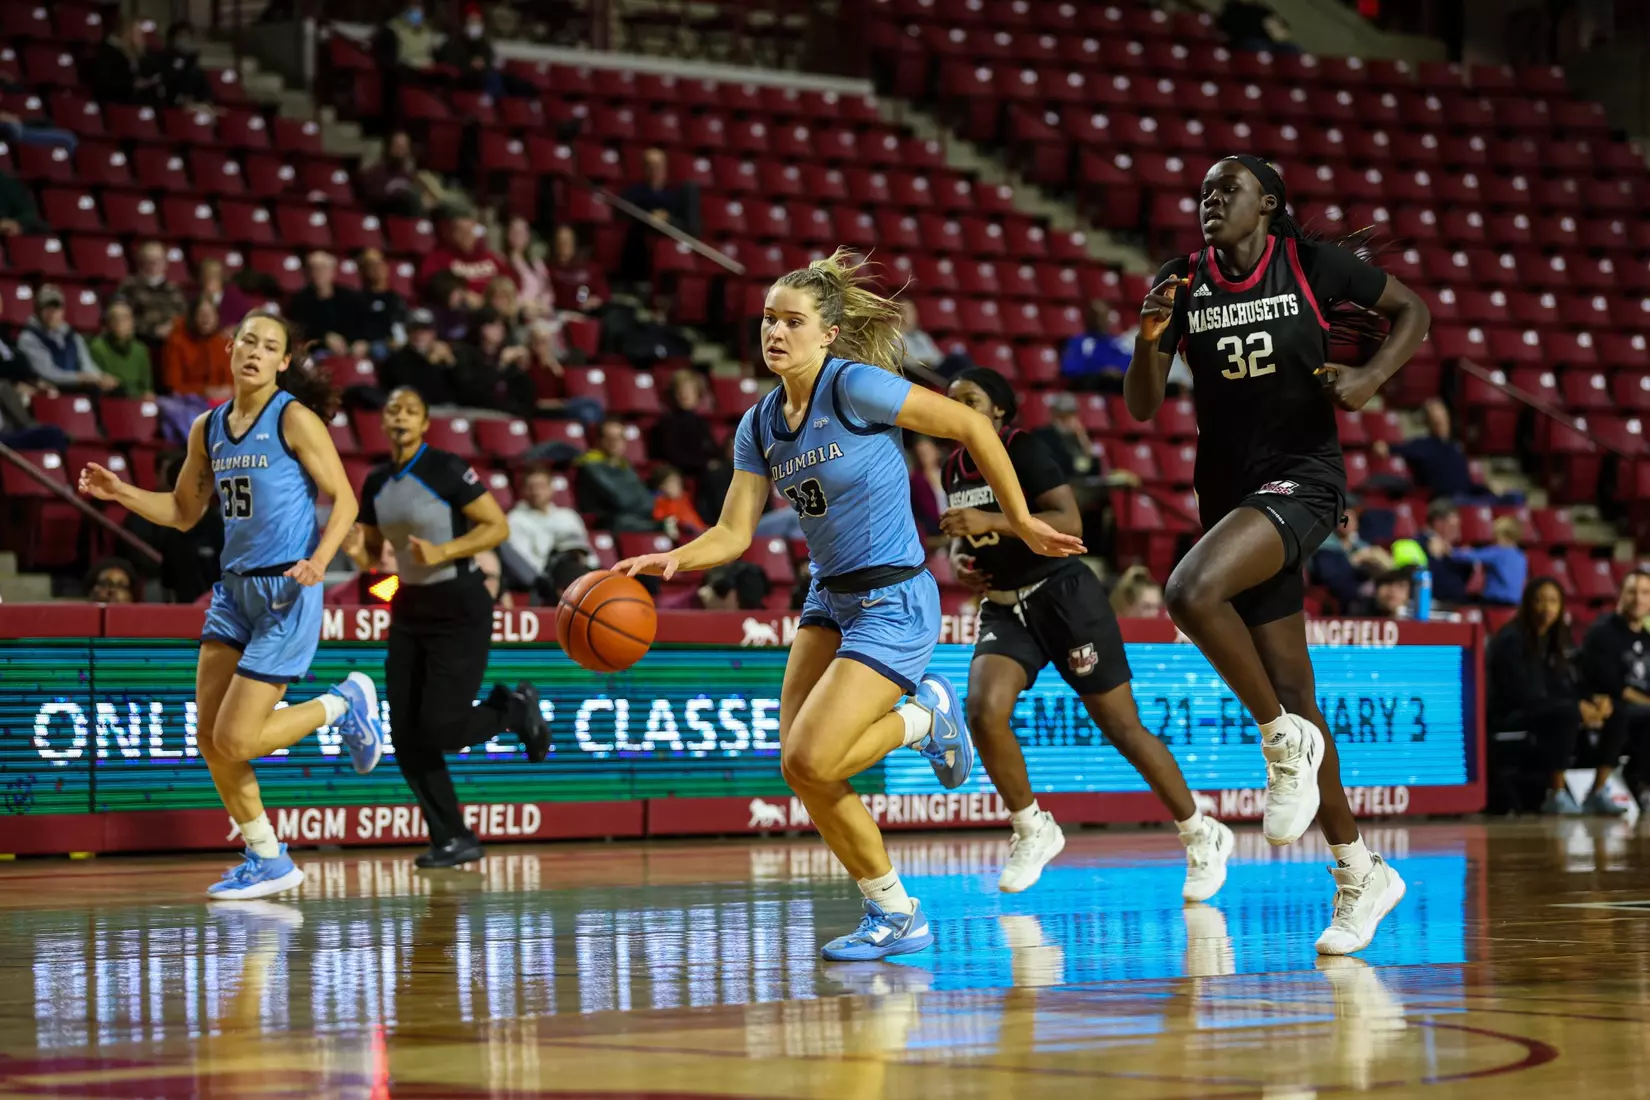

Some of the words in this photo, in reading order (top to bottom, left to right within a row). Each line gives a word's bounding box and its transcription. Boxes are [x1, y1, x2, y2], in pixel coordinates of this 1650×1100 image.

[1187, 293, 1299, 333] MASSACHUSETTS
[1216, 330, 1276, 380] 32
[211, 454, 269, 472] COLUMBIA
[771, 442, 844, 481] OLUMBIA
[1305, 619, 1400, 649] INGFIELD
[34, 698, 290, 765] ONLI
[574, 694, 781, 757] CLASSE
[1410, 697, 1427, 742] 3
[277, 807, 346, 841] MGM
[357, 803, 542, 840] SPRIFIELD
